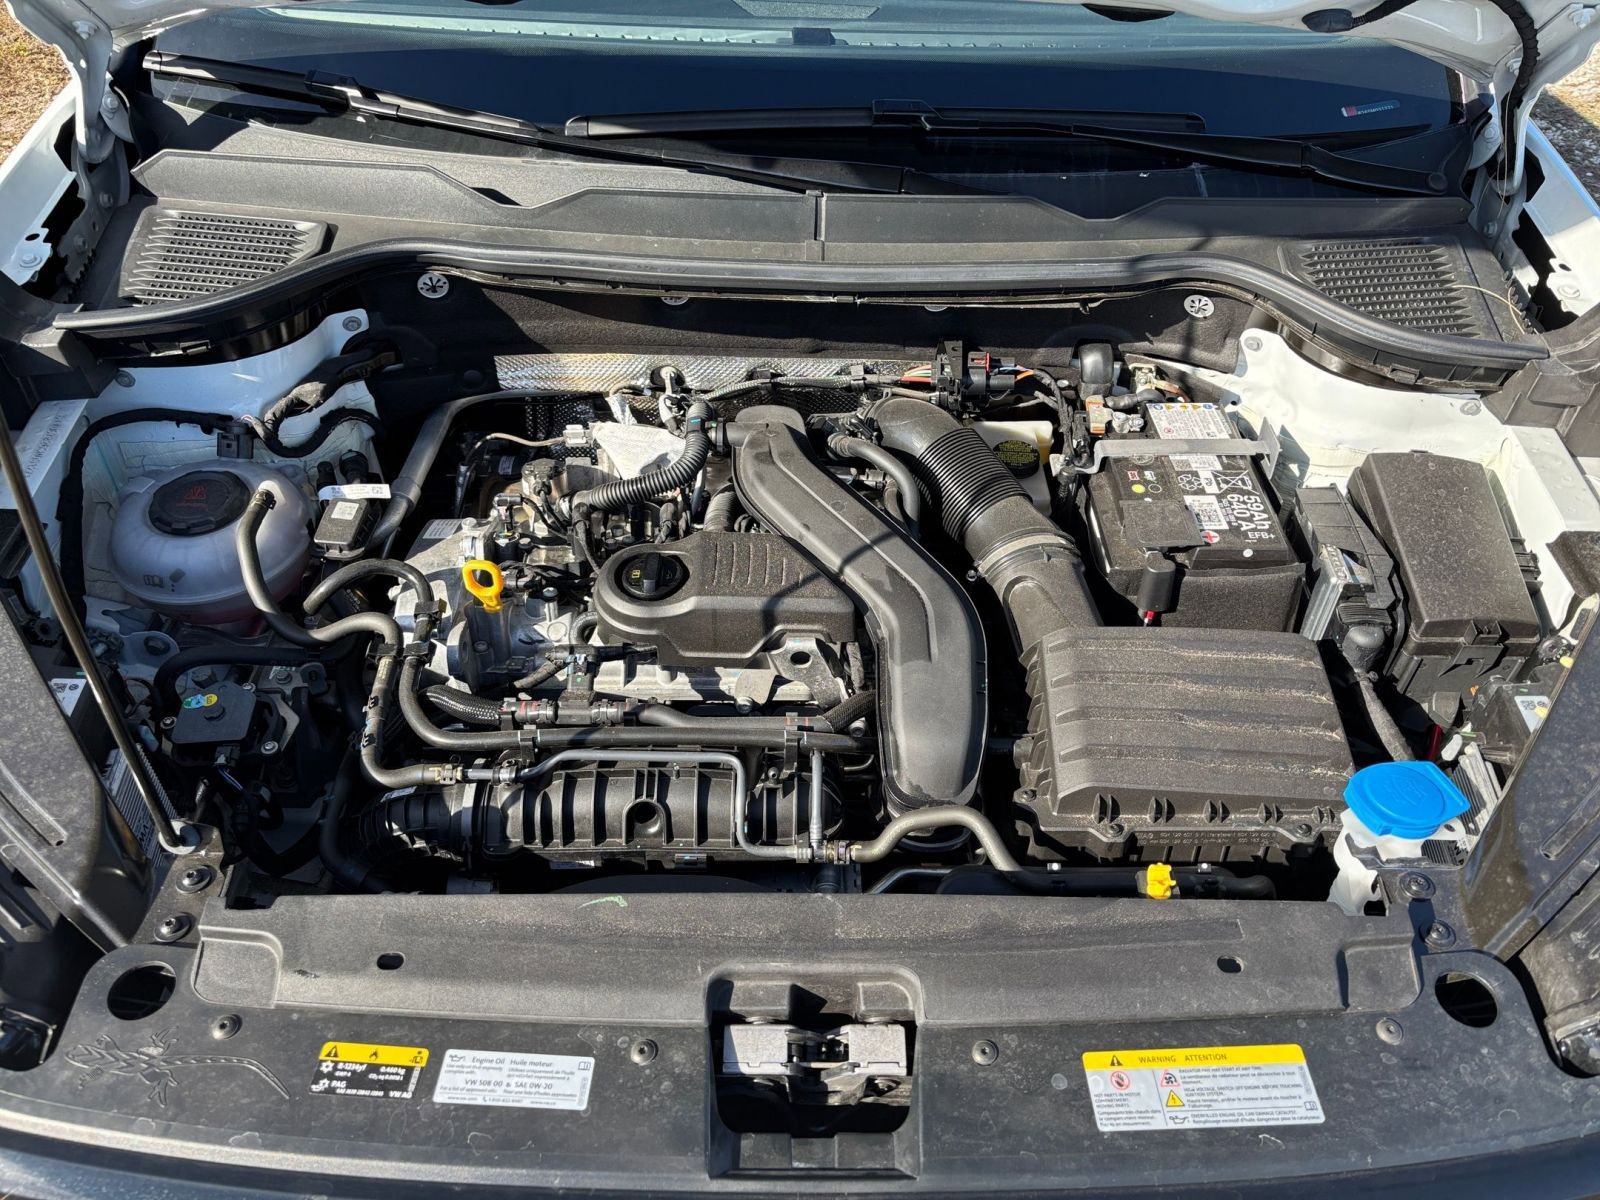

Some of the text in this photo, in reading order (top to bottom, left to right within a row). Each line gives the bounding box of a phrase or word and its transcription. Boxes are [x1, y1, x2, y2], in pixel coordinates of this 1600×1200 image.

[1226, 493, 1251, 517] 640
[1243, 495, 1272, 530] 59Ah
[1237, 520, 1256, 531] A
[472, 1057, 505, 1065] Engine Oil
[1138, 1053, 1228, 1063] WARNING ATTENTION
[330, 1080, 347, 1088] PAG
[389, 1090, 401, 1098] VW
